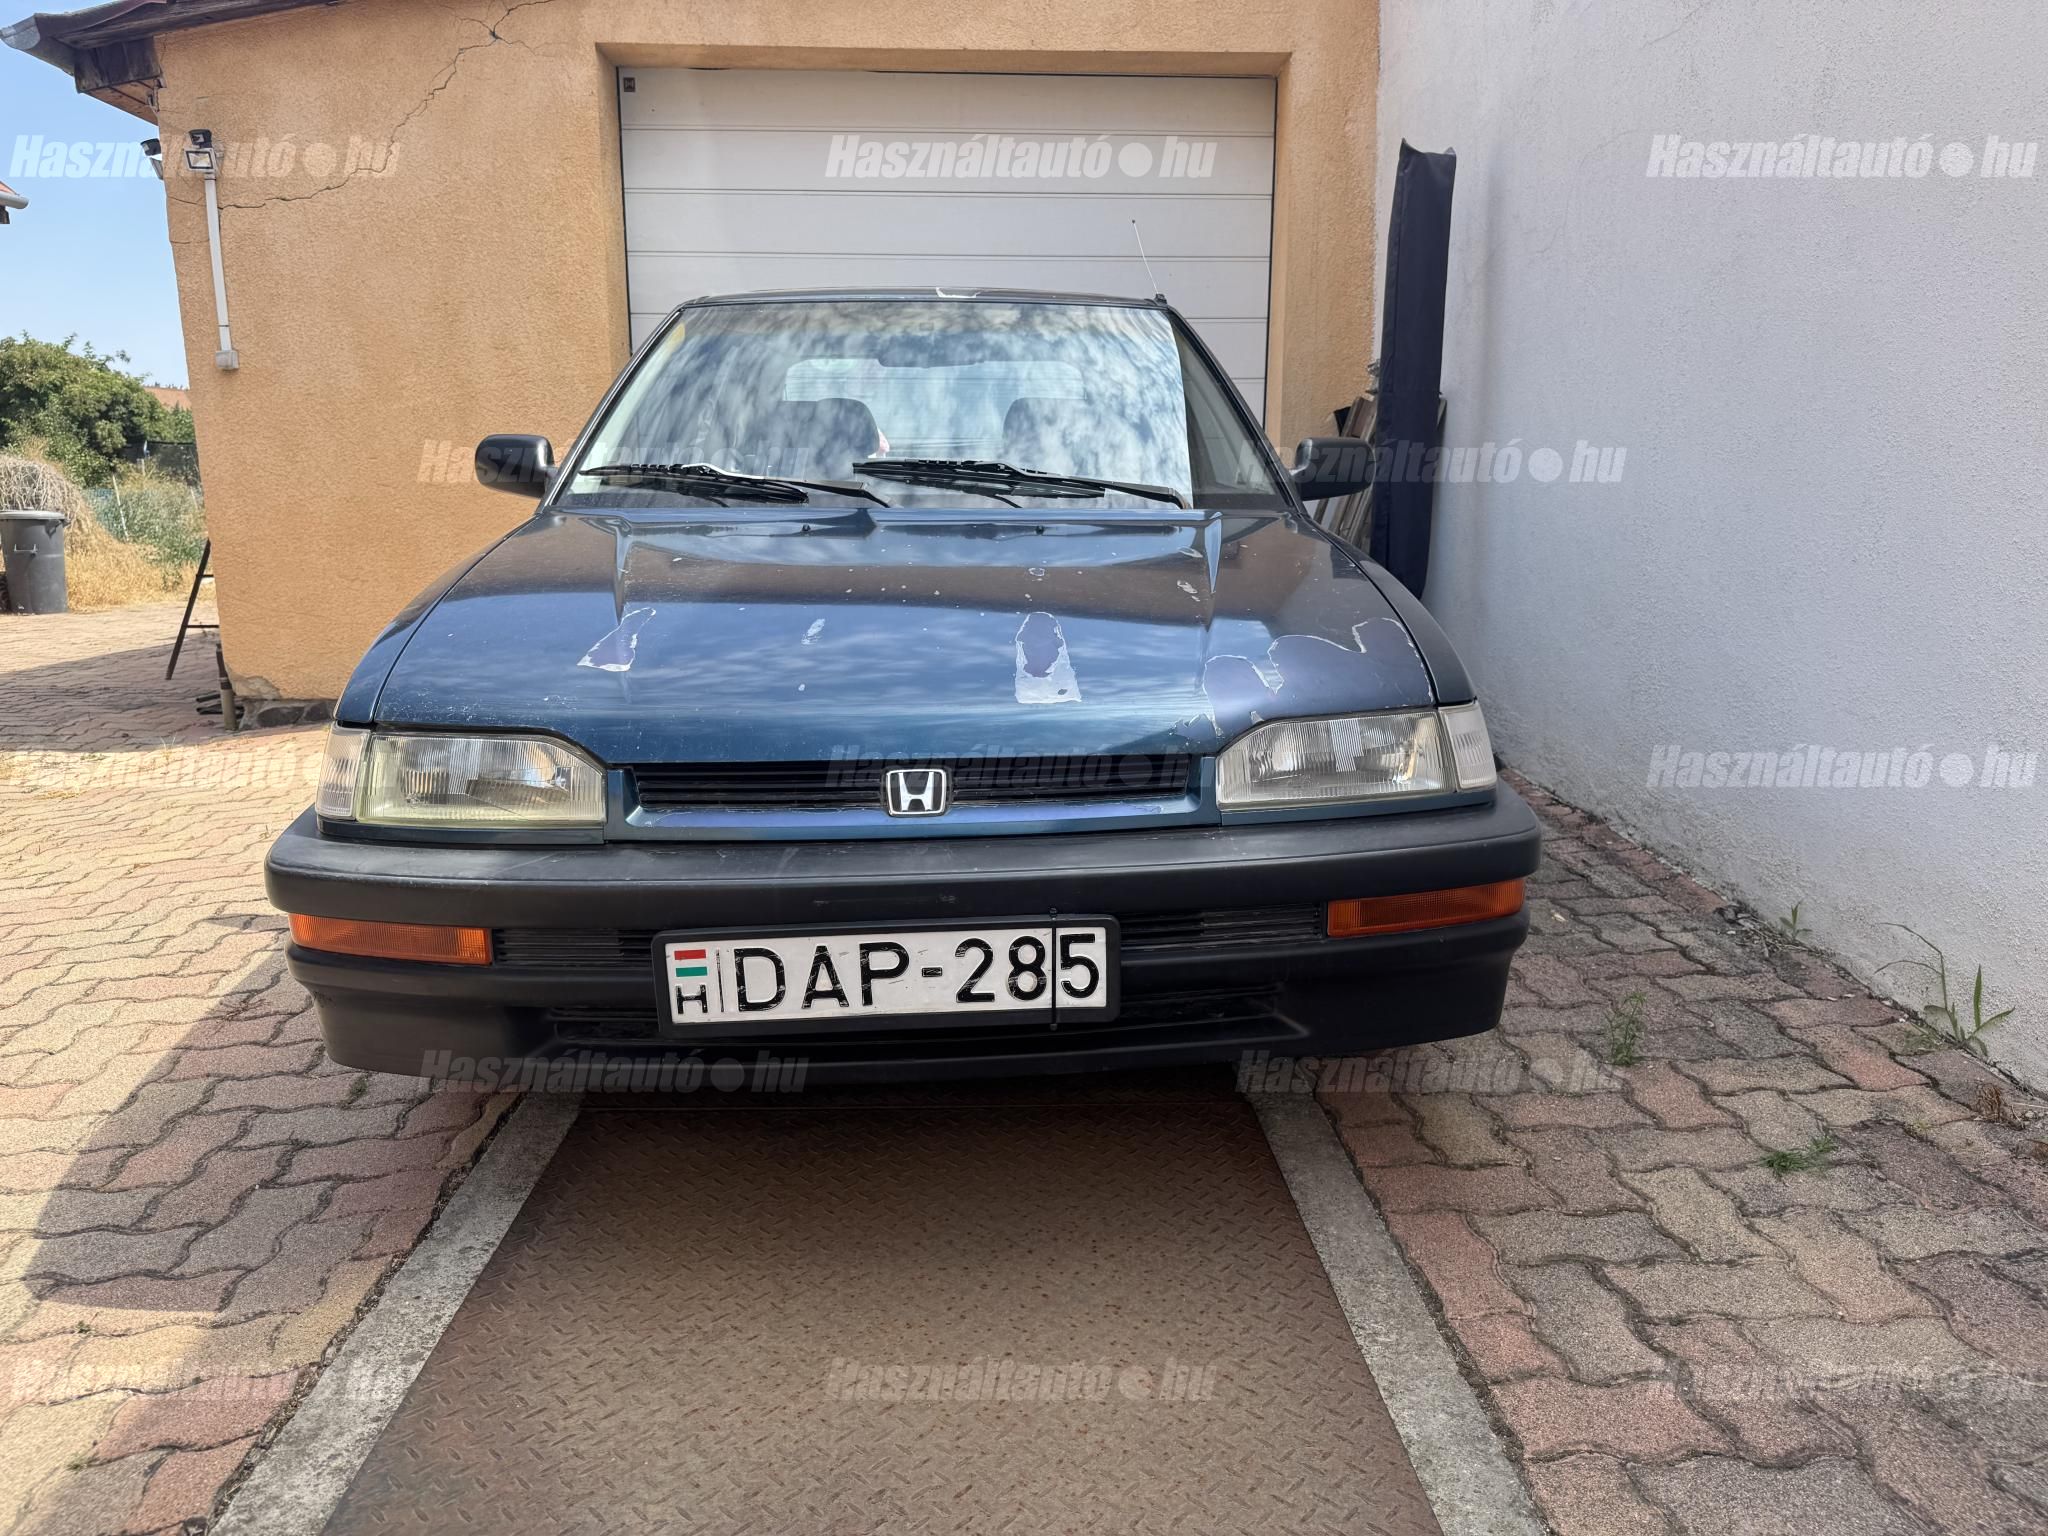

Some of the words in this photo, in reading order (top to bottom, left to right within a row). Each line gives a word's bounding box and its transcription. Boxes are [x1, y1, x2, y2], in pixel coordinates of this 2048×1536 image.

[897, 771, 935, 812] H
[733, 933, 1100, 1012] DAP-285
[675, 984, 708, 1015] H
